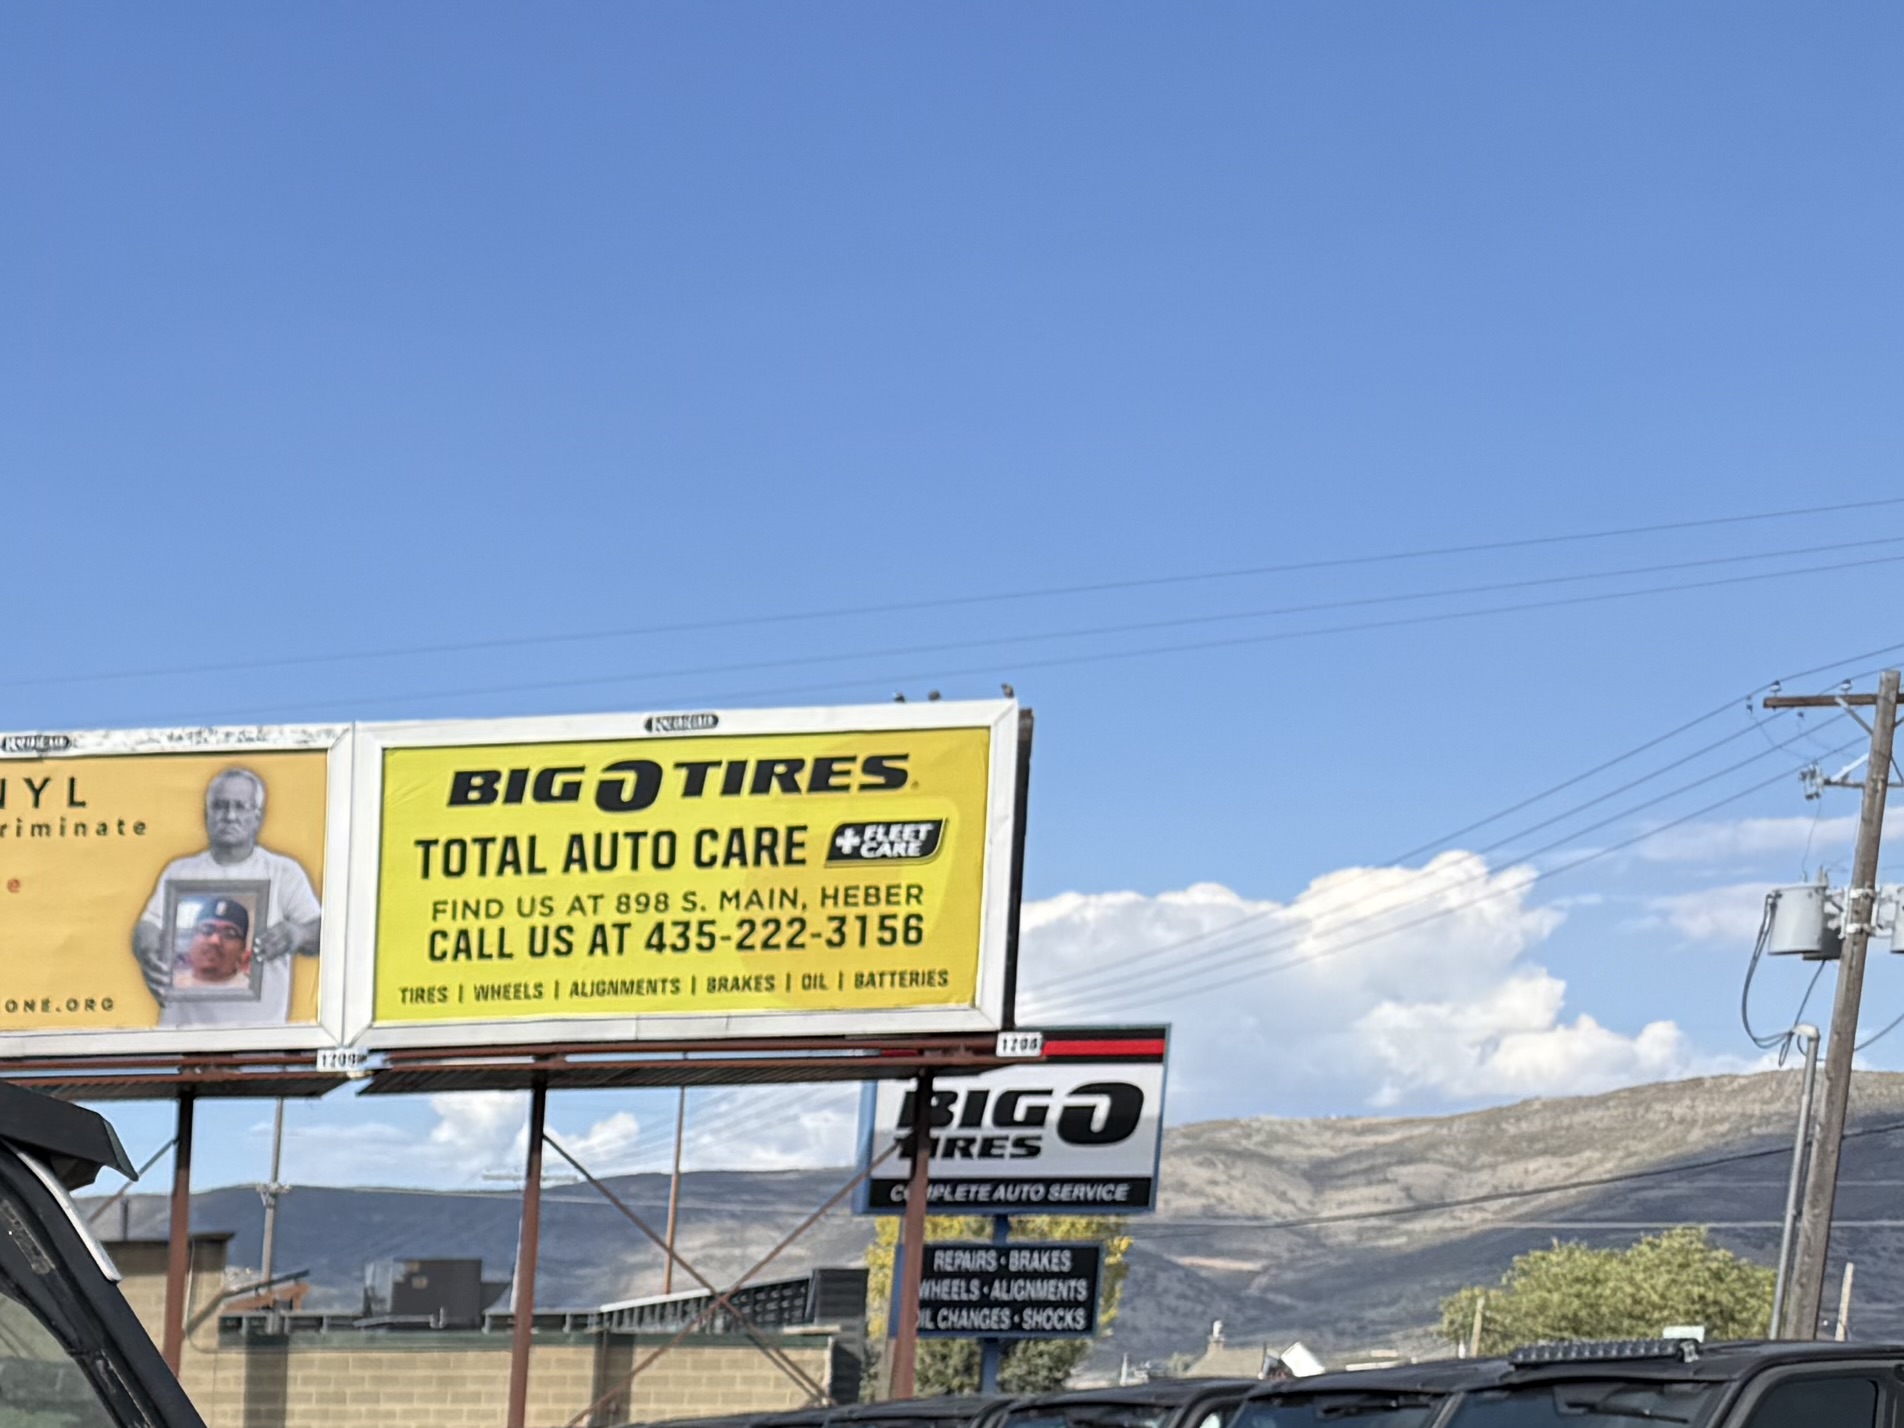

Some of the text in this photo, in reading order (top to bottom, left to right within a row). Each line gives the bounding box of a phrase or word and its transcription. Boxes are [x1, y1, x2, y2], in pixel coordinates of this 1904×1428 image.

[447, 753, 911, 813] BIG O TIRES
[864, 823, 934, 842] FLEET
[414, 825, 808, 879] TOTAL AUTO CARE
[860, 841, 923, 858] CARE
[431, 884, 924, 922] FIND US AT 898 S. MAIN, HEBER
[428, 913, 925, 962] CALL US AT 435-222-3156
[399, 969, 949, 1004] TIRES WHEELS ALIGNMENTS BRAKES OIL BATTERIES
[896, 1082, 1145, 1147] BIG O
[890, 1183, 1130, 1202] CPLETE AUTO SERVICE
[933, 1249, 1072, 1272] REPAIRS BRAKES
[990, 1278, 1088, 1301] ALIGNMENTS
[937, 1307, 1012, 1330] CHANGES
[1021, 1306, 1086, 1330] SHOCKS
